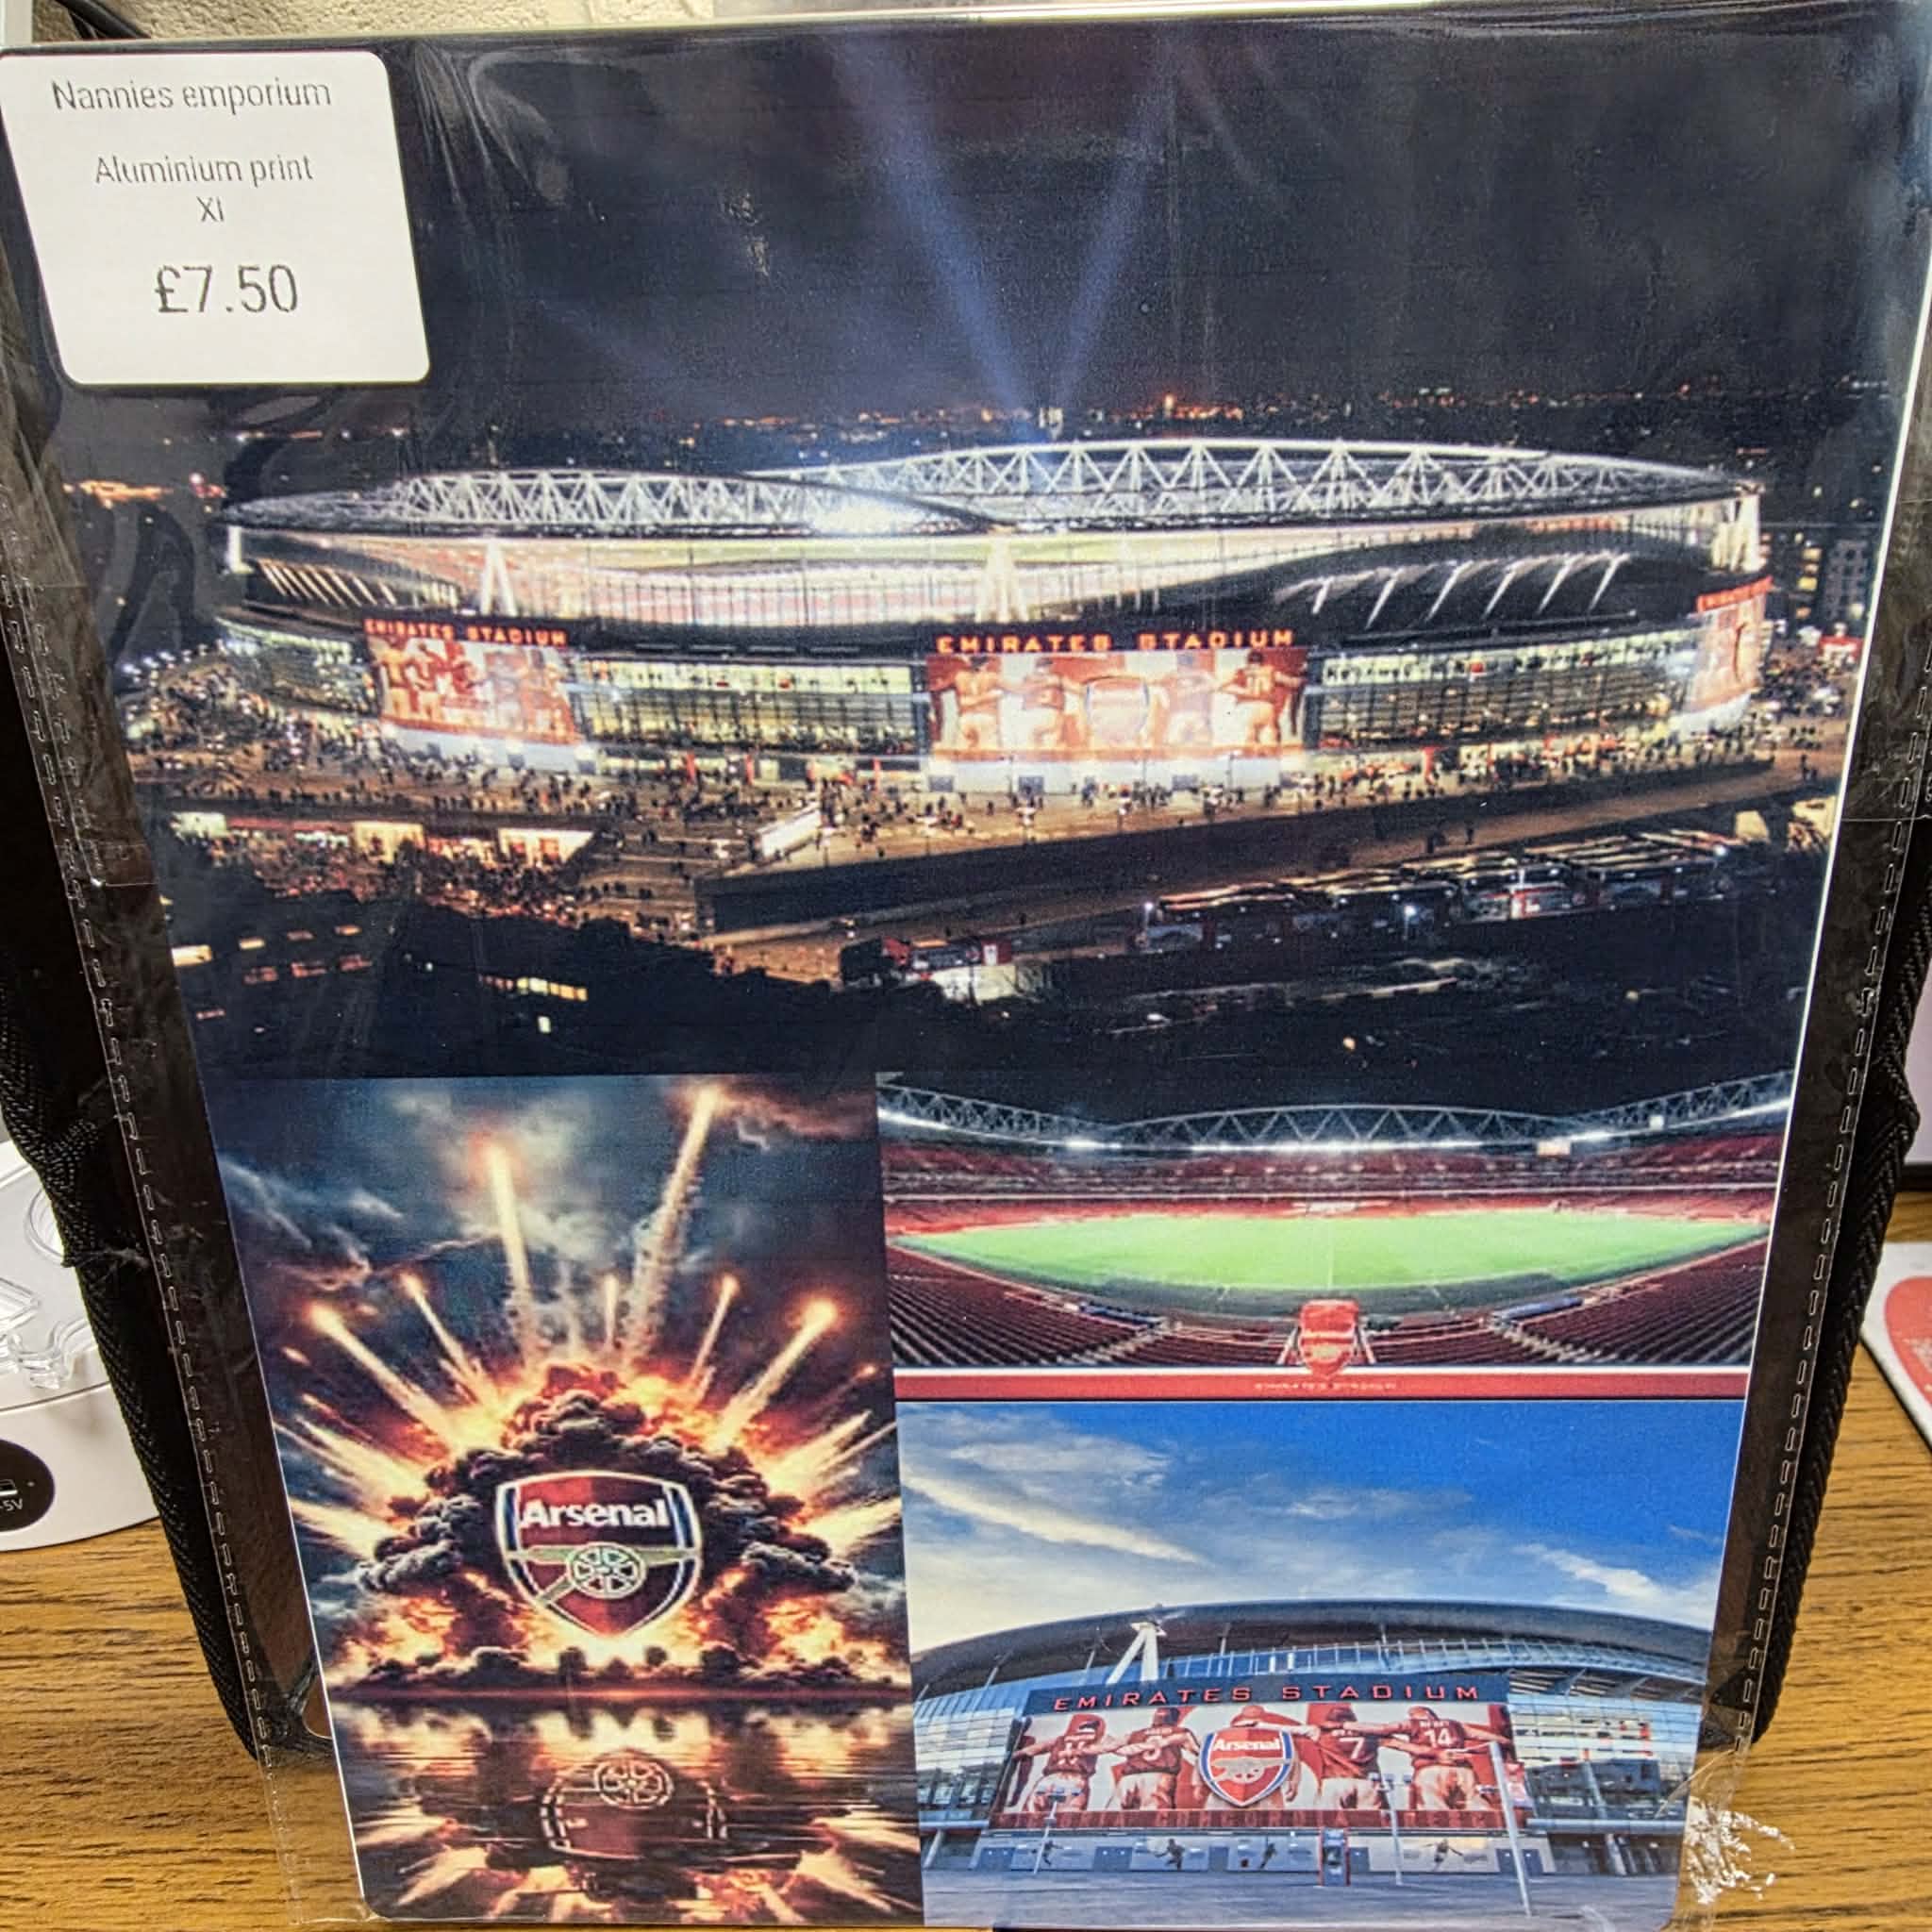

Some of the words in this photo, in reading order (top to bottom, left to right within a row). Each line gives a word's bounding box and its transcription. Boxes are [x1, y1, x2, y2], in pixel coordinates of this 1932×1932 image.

[51, 79, 174, 111] Nannies
[182, 76, 331, 116] emporium
[95, 155, 243, 184] Aluminium
[249, 154, 314, 189] print
[155, 264, 298, 313] £7.50
[465, 625, 568, 645] STADIUM
[936, 633, 1113, 654] EMIRATES
[1138, 629, 1294, 650] STADIUM
[520, 1498, 671, 1528] Arsenal
[1053, 1687, 1252, 1712] EMIRATES
[1281, 1685, 1479, 1701] STADIUM
[1212, 1737, 1281, 1752] Arsenal
[1339, 1737, 1366, 1759] 7
[1424, 1728, 1454, 1749] 14
